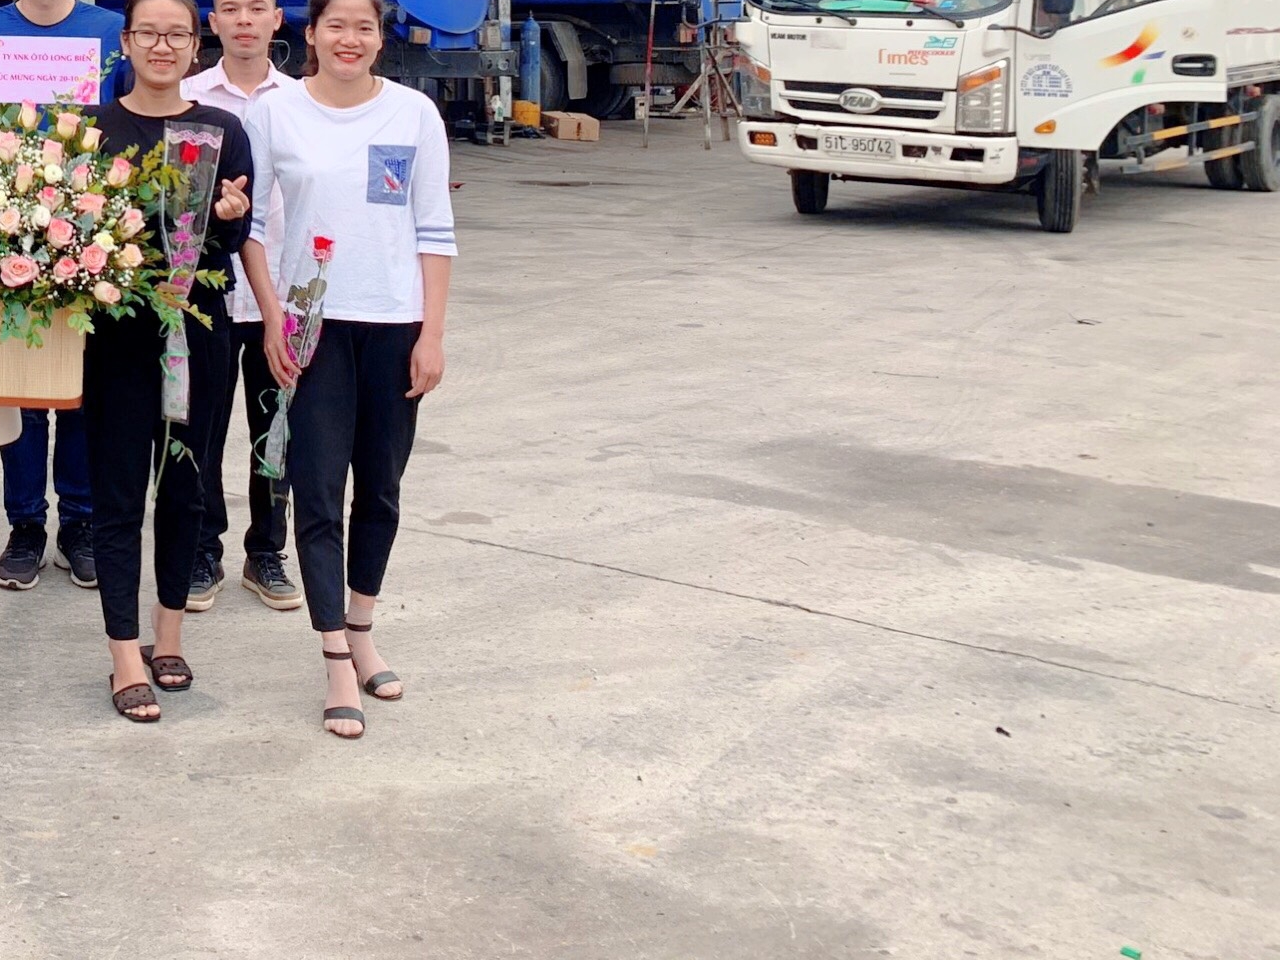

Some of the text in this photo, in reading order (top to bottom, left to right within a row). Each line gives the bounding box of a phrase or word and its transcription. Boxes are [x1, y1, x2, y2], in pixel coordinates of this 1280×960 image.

[3, 53, 11, 61] TY
[50, 54, 73, 62] LONG
[843, 95, 875, 108] VEAM
